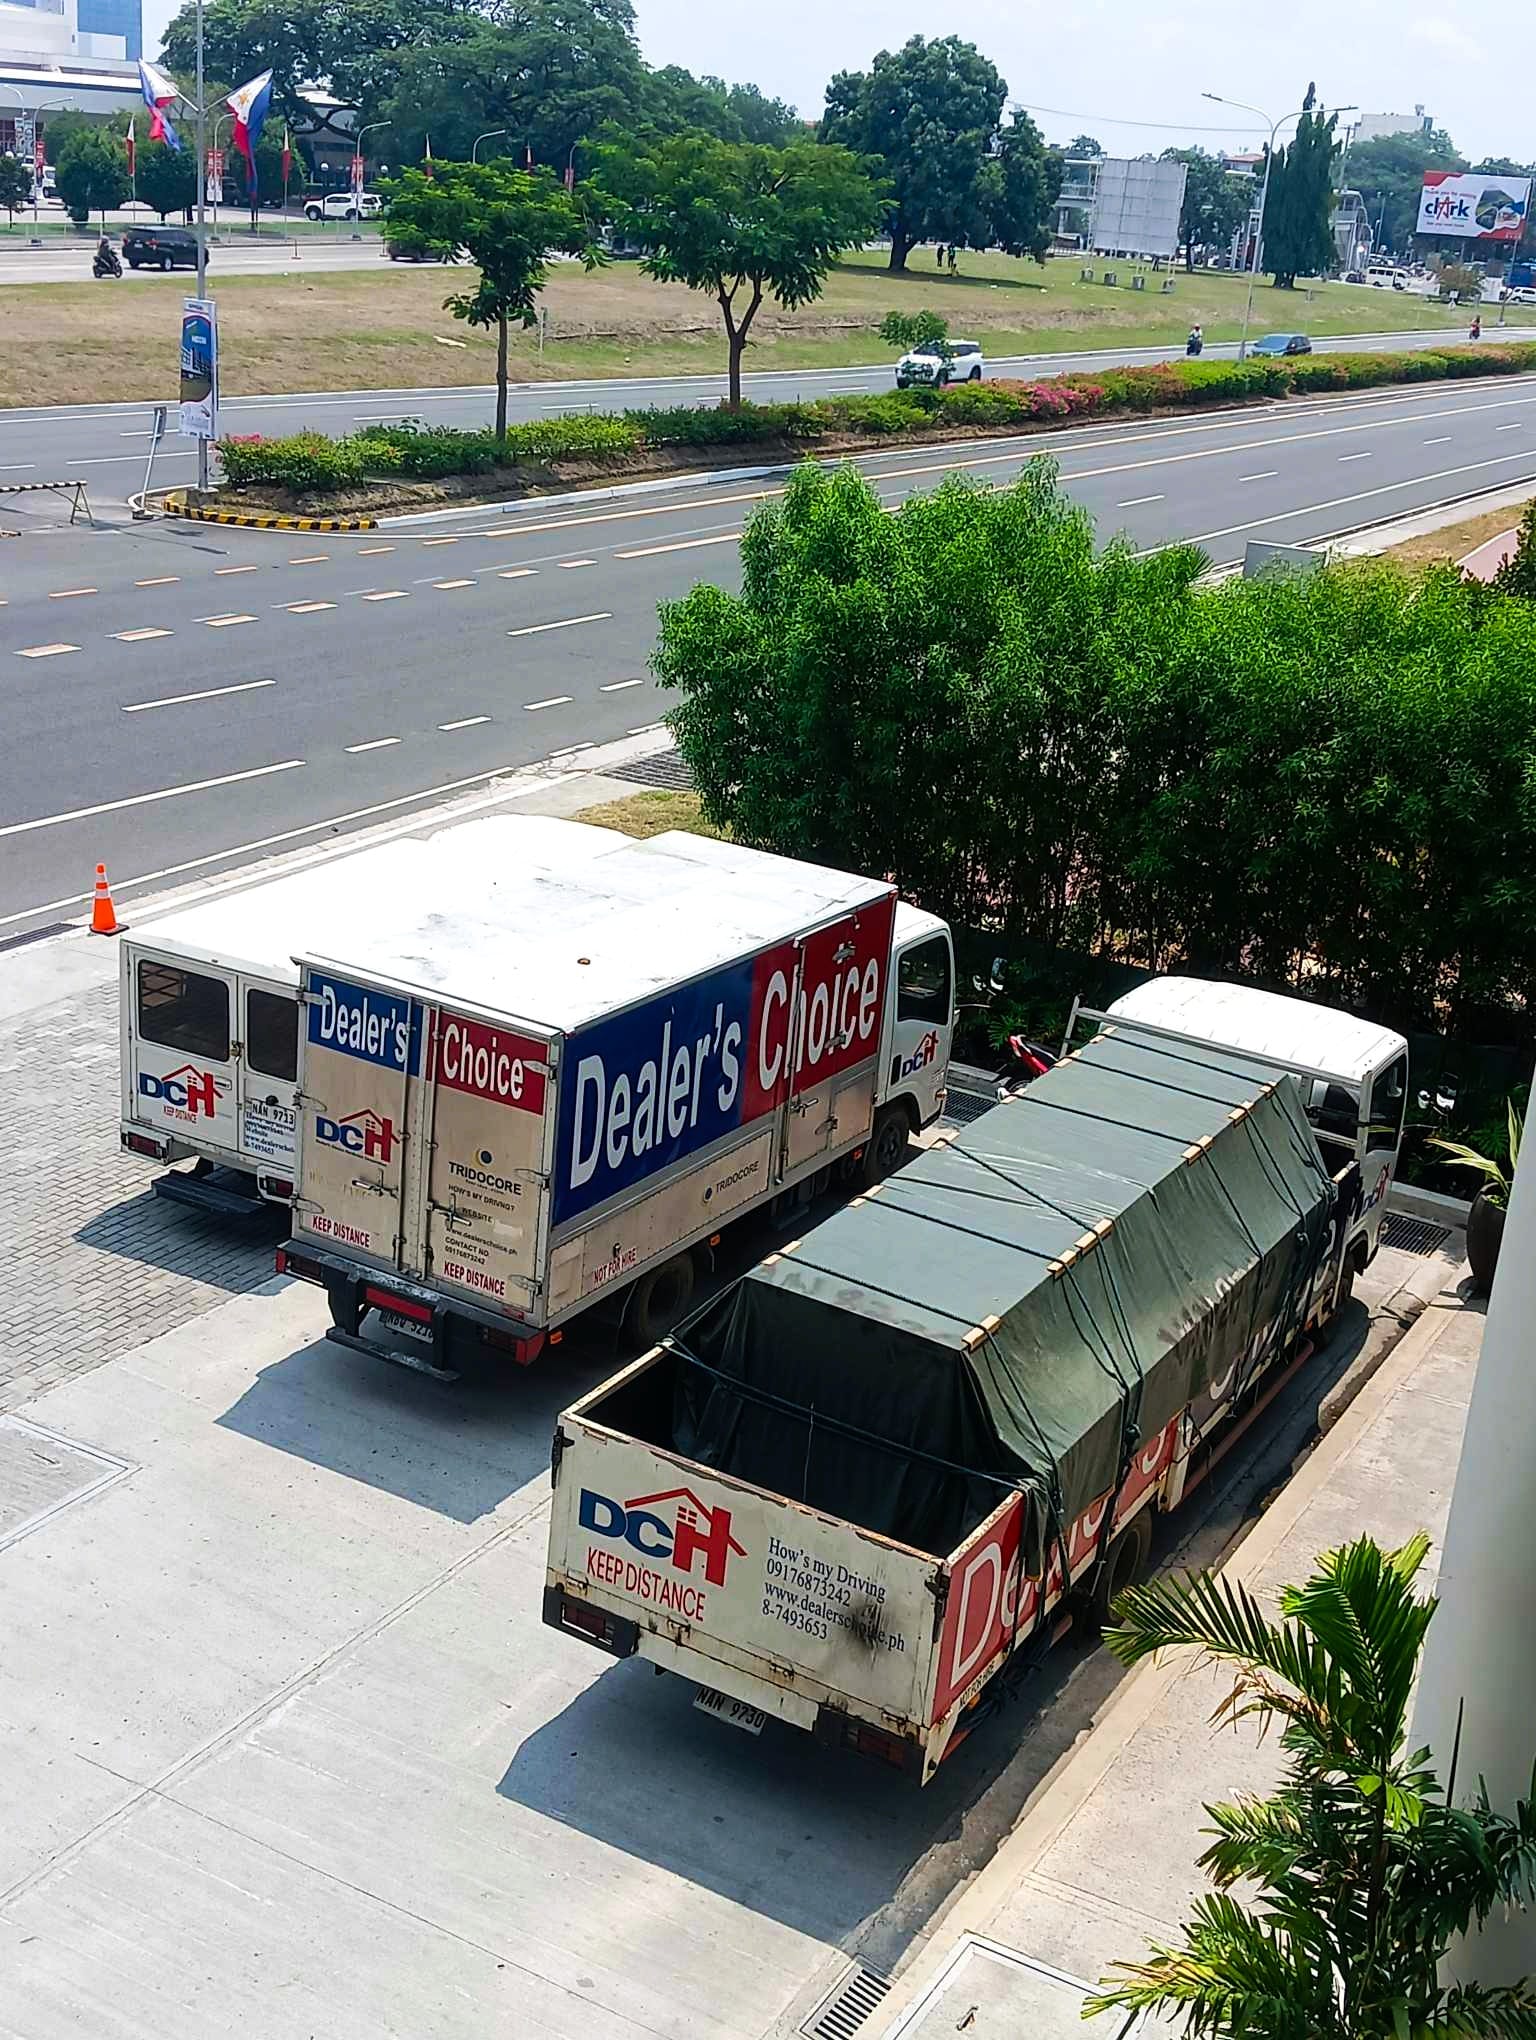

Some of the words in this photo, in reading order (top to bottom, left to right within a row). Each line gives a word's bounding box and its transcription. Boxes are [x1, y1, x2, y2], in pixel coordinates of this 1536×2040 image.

[320, 984, 408, 1063] Dealer's
[443, 1022, 524, 1100] Choice
[902, 1030, 937, 1078] DCH
[139, 1070, 217, 1118] DCH
[570, 1003, 742, 1191] Dealer's
[758, 957, 879, 1093] Choice
[315, 1115, 393, 1163] DCH
[448, 1161, 522, 1196] TRIDOCORE
[716, 1160, 759, 1193] TRIDOCORE
[312, 1214, 332, 1234] KEEP
[333, 1221, 370, 1249] DISTANCE
[444, 1236, 477, 1254] CONTACT
[443, 1260, 465, 1281] KEEP
[466, 1268, 505, 1296] DISTANCE
[578, 1487, 733, 1588] DCH
[586, 1546, 624, 1586] KEEP
[625, 1562, 706, 1623] DISTANCE
[766, 1558, 851, 1608] 09176873242
[768, 1536, 810, 1569] How's
[813, 1559, 834, 1582] my
[837, 1565, 887, 1605] Driving
[762, 1598, 828, 1641] 8-7493653
[696, 1687, 726, 1712] NAN
[729, 1702, 767, 1729] 9730
